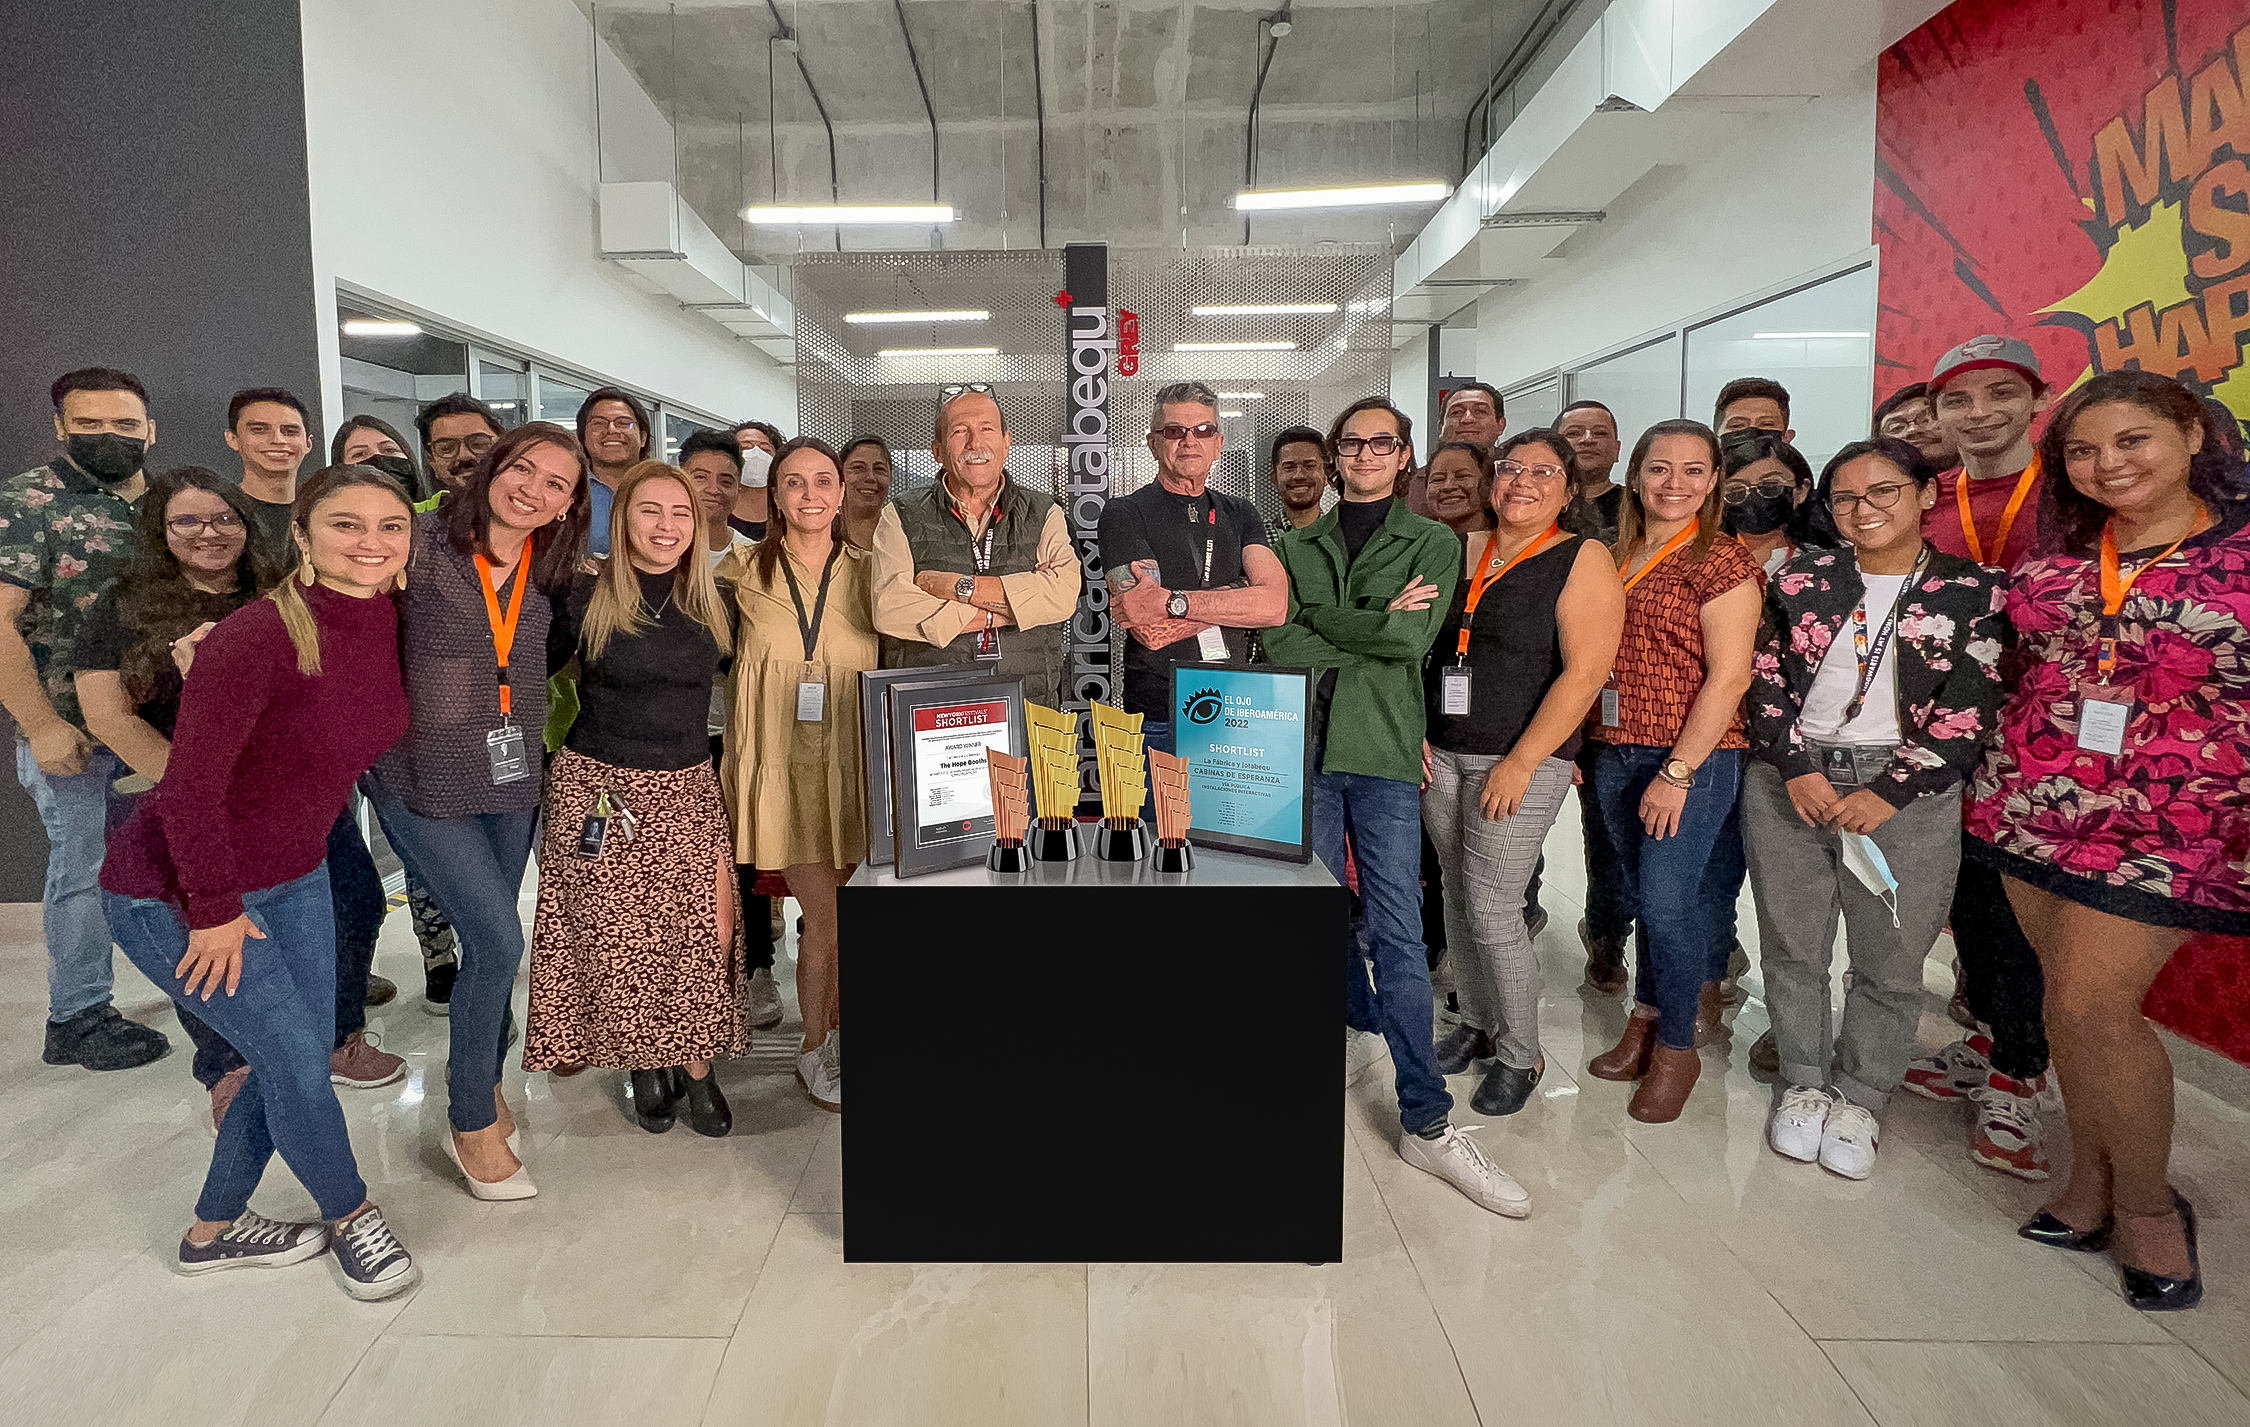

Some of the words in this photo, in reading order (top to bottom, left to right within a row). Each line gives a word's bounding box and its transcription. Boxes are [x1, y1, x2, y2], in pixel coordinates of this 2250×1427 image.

[2094, 22, 2250, 226] MA
[1119, 308, 1139, 376] GREY
[1224, 695, 1235, 705] EL
[1236, 696, 1252, 706] OJO
[935, 714, 988, 727] SHORTLIST
[1224, 707, 1235, 716] DE
[1237, 708, 1299, 722] IBEROAMÉRICA
[1224, 718, 1249, 728] 2022
[1209, 743, 1265, 758] SHORTLIST
[951, 760, 967, 768] Hope
[967, 758, 988, 766] Booths
[1193, 768, 1224, 777] CABINAS
[1226, 771, 1236, 779] DE
[1237, 772, 1281, 784] ESPERANZA
